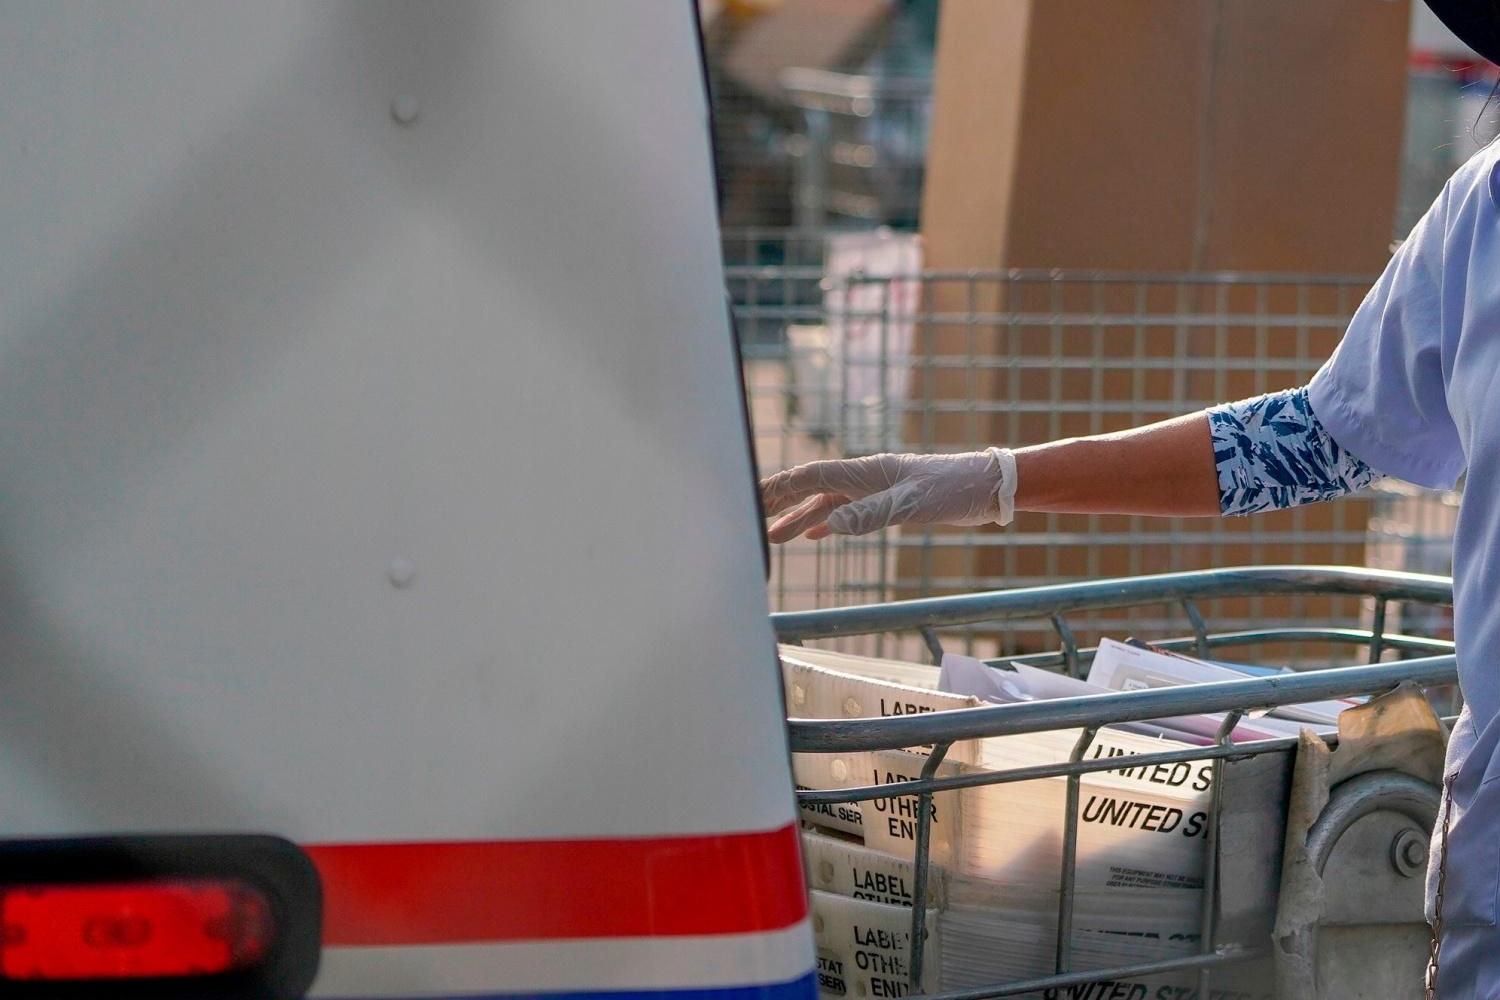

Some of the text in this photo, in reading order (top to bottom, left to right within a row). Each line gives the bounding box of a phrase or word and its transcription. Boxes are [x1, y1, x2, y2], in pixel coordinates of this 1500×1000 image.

[838, 807, 863, 825] SER
[1082, 796, 1183, 833] UNITED
[888, 818, 917, 840] EN
[853, 868, 911, 898] LABEL
